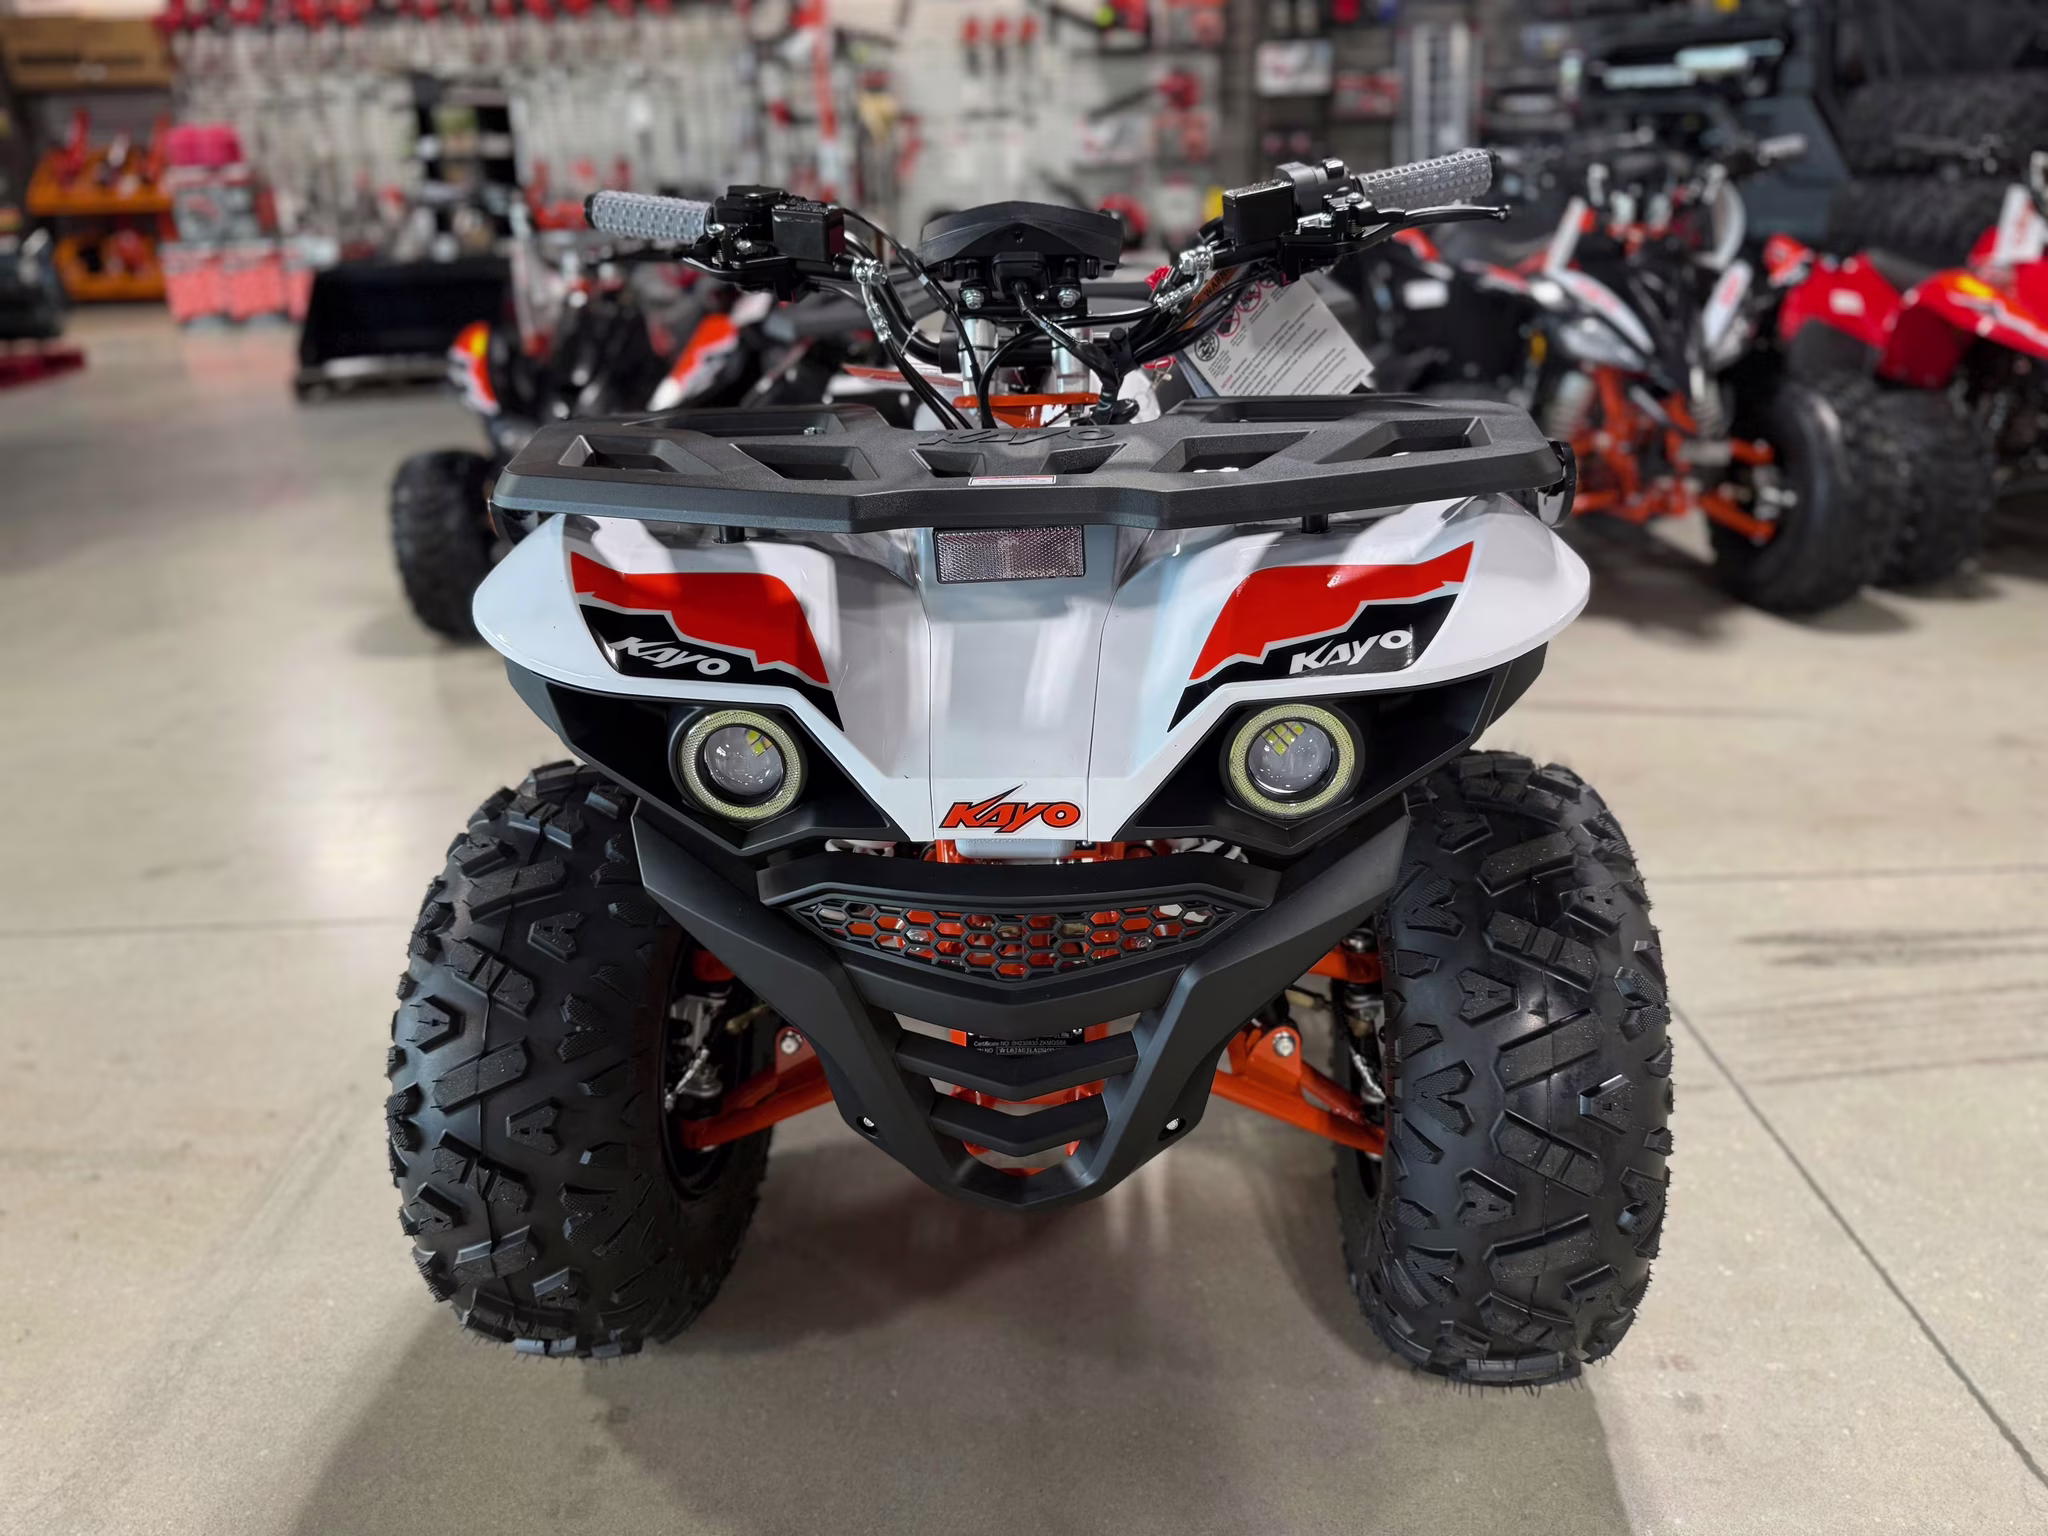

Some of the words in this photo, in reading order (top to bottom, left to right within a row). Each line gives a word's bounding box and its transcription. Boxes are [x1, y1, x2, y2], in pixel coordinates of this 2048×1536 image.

[608, 636, 731, 675] KAYO
[1288, 629, 1413, 675] KAYO
[938, 783, 1081, 833] KAYO
